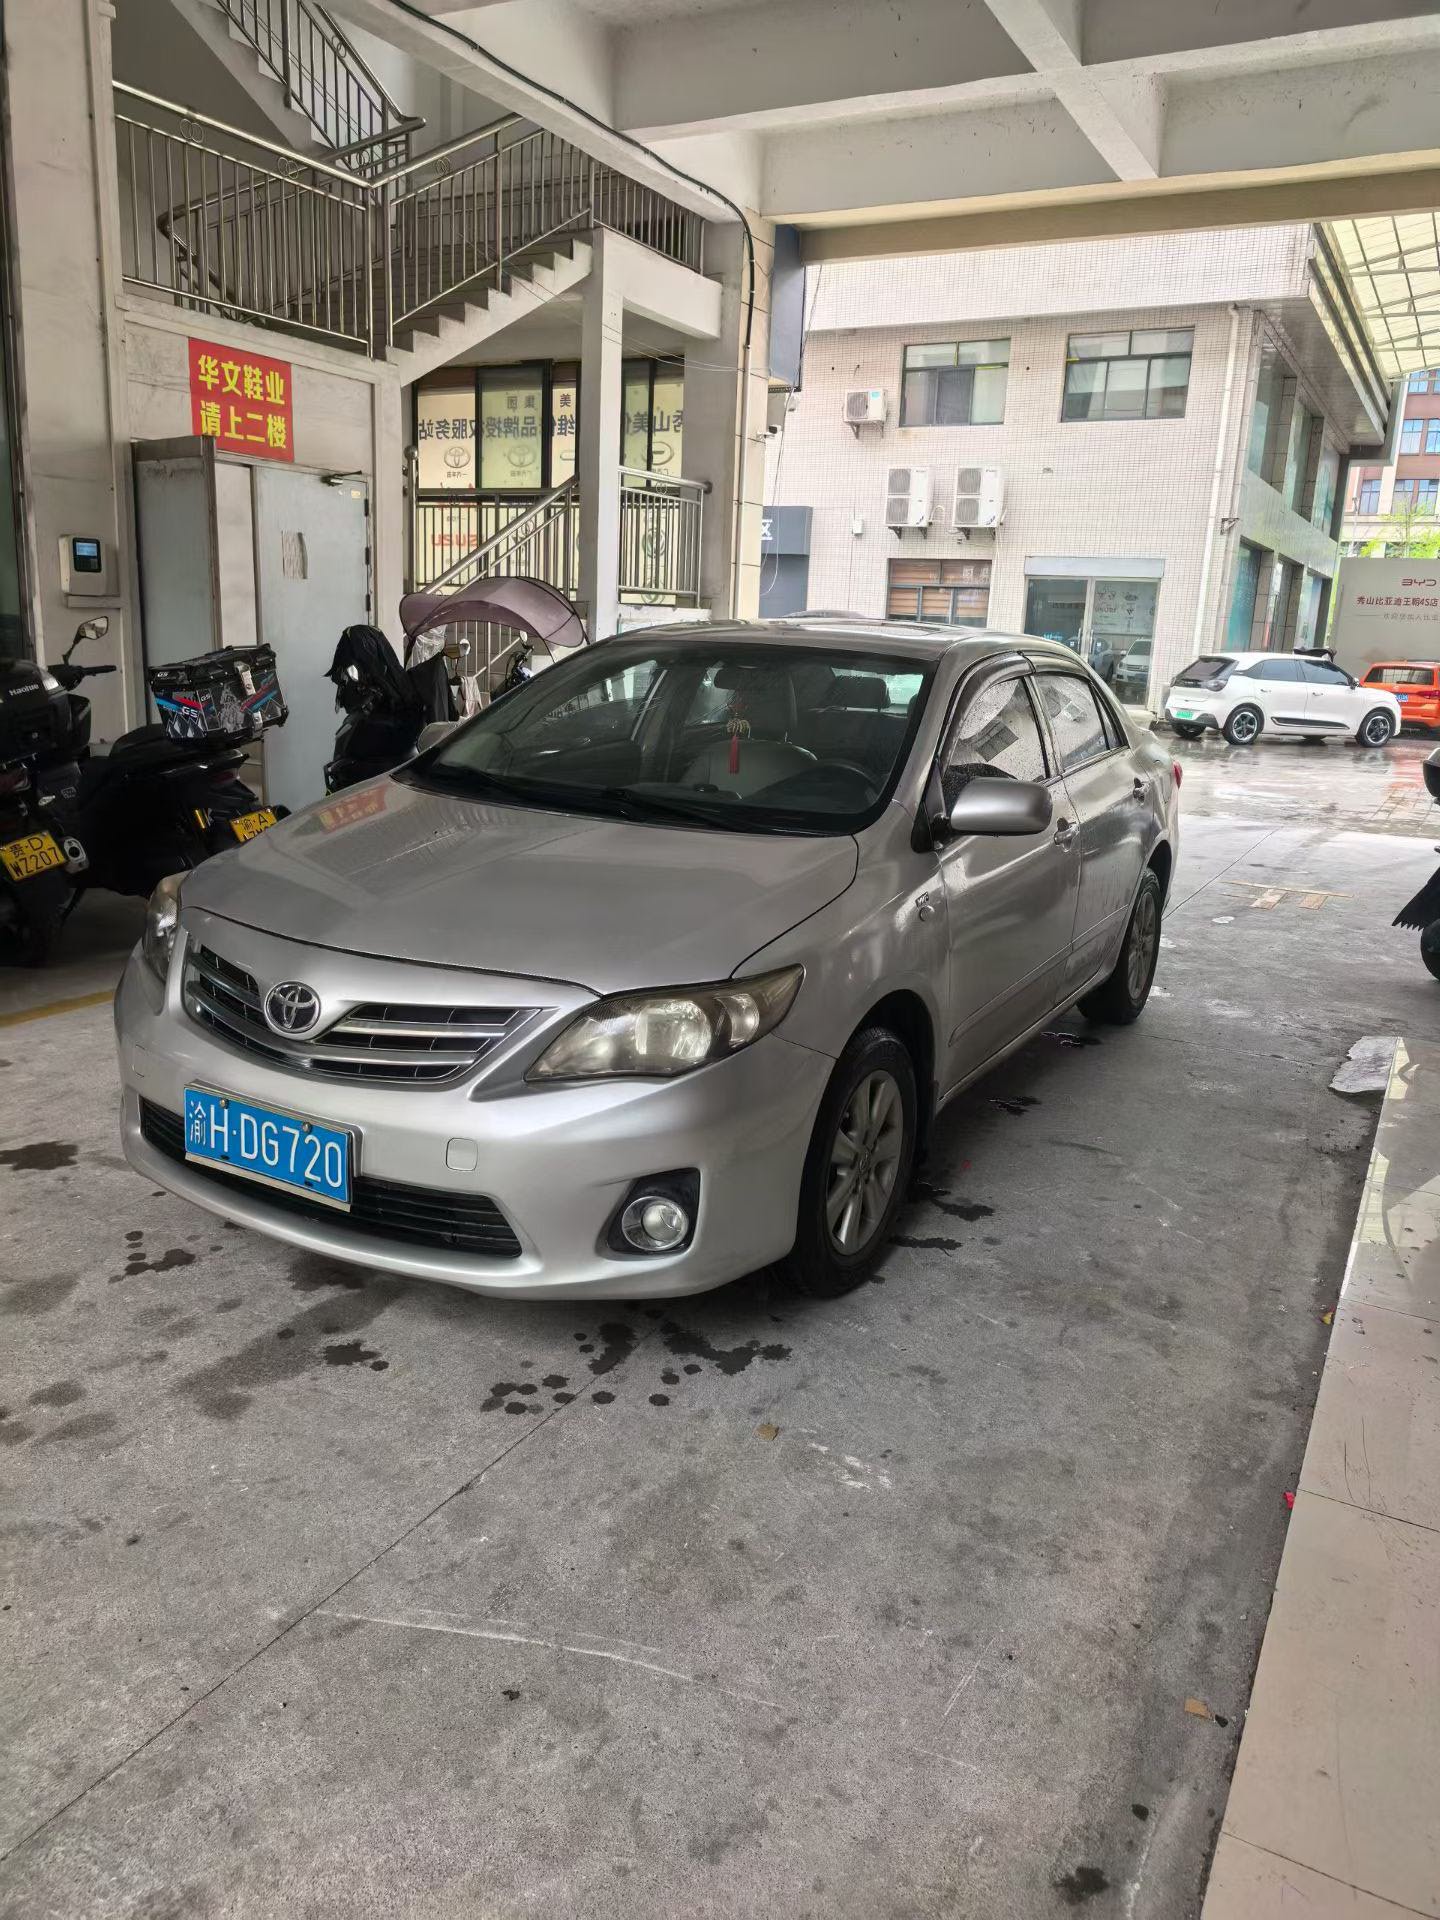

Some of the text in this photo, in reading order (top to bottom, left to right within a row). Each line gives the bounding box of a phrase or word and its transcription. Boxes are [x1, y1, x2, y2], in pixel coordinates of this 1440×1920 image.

[198, 354, 285, 405] 华文鞋业
[200, 400, 287, 449] 请上二楼
[1401, 578, 1437, 587] BYD
[181, 705, 199, 719] GS
[9, 847, 60, 877] WZ207
[189, 1100, 343, 1188] 渝H·DG720
